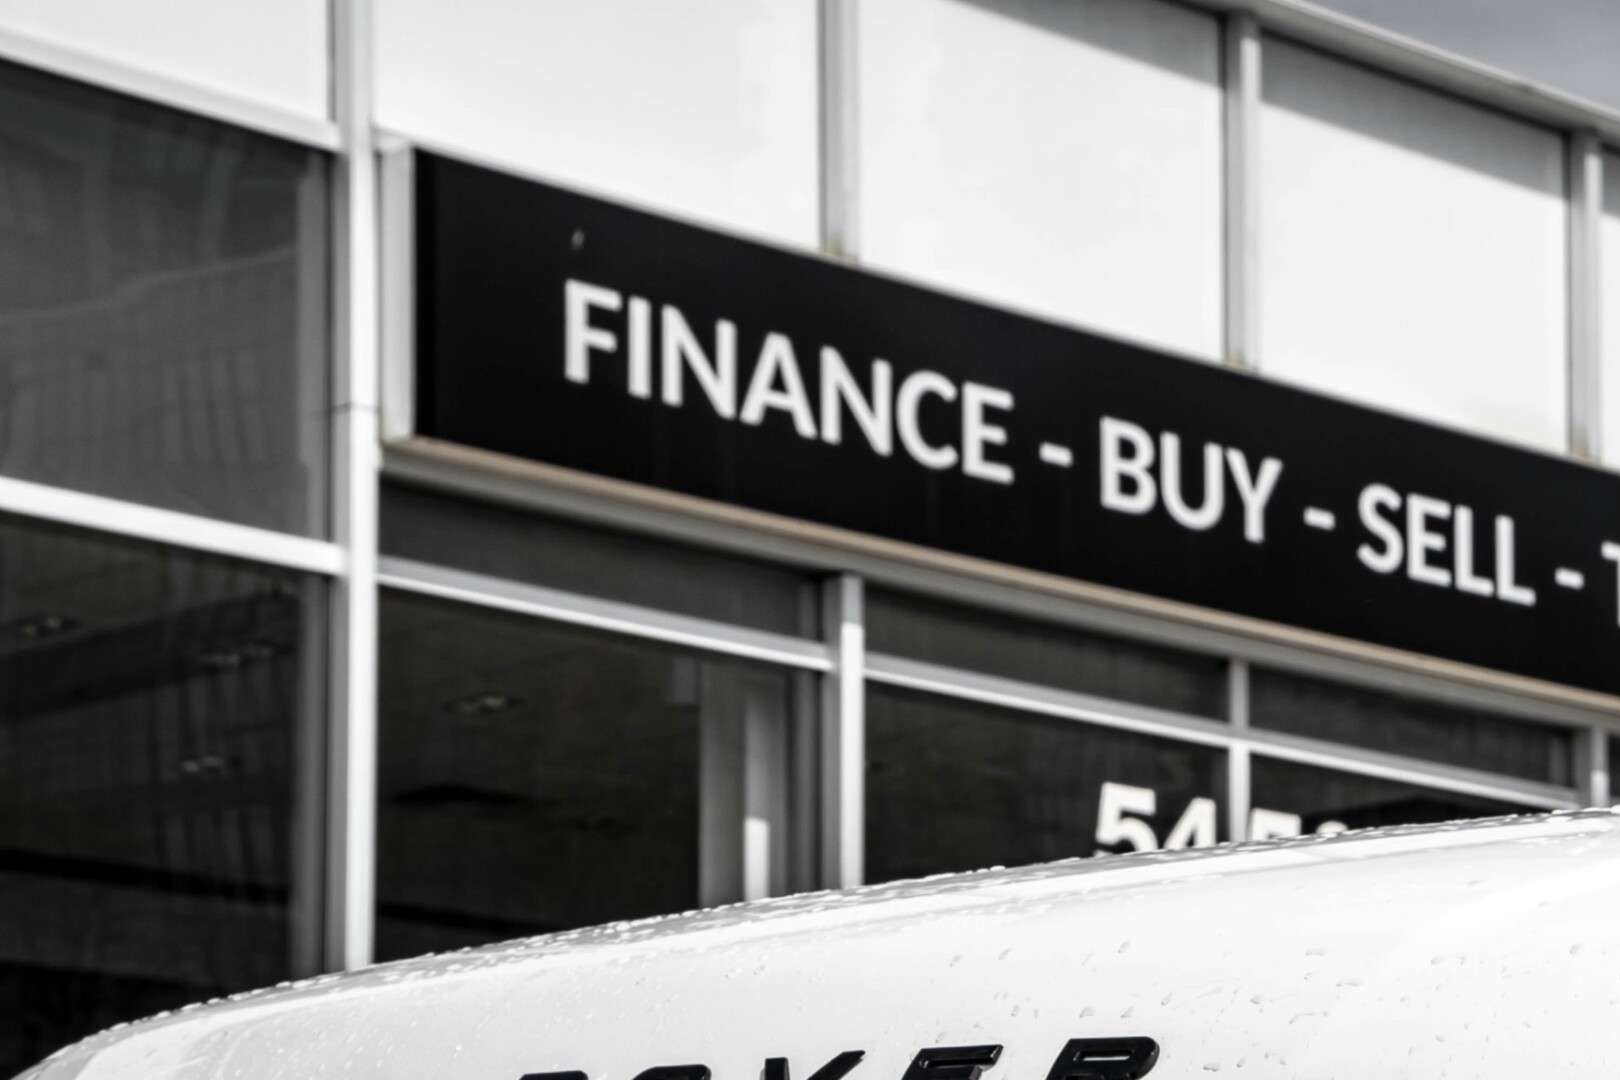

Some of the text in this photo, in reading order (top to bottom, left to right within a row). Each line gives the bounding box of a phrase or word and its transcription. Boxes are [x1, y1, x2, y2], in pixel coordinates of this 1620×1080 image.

[564, 278, 1014, 484] FINANCE
[1099, 415, 1283, 543] BUY
[1356, 483, 1537, 606] SELL
